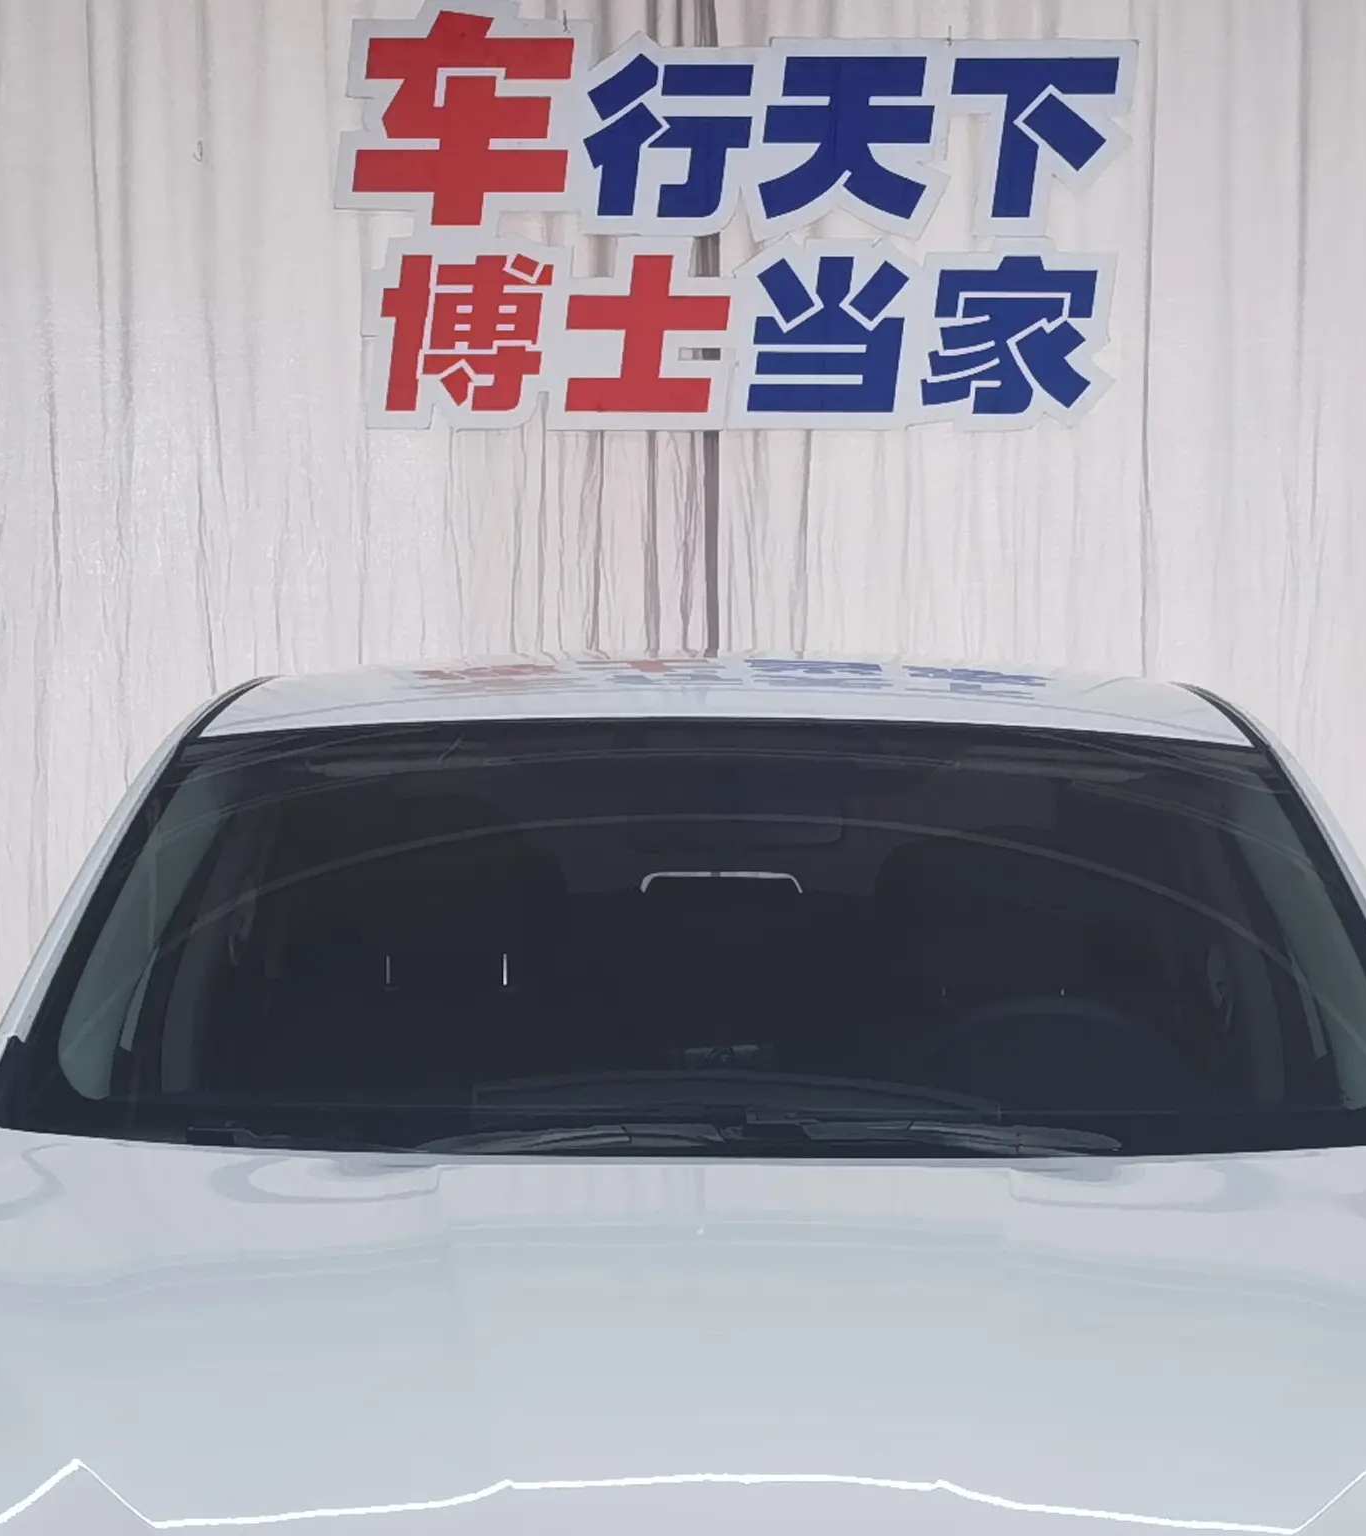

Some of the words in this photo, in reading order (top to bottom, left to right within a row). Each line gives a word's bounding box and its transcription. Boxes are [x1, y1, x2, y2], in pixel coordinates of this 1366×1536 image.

[352, 9, 1121, 226] 车行天下
[381, 254, 1099, 415] 博士当家
